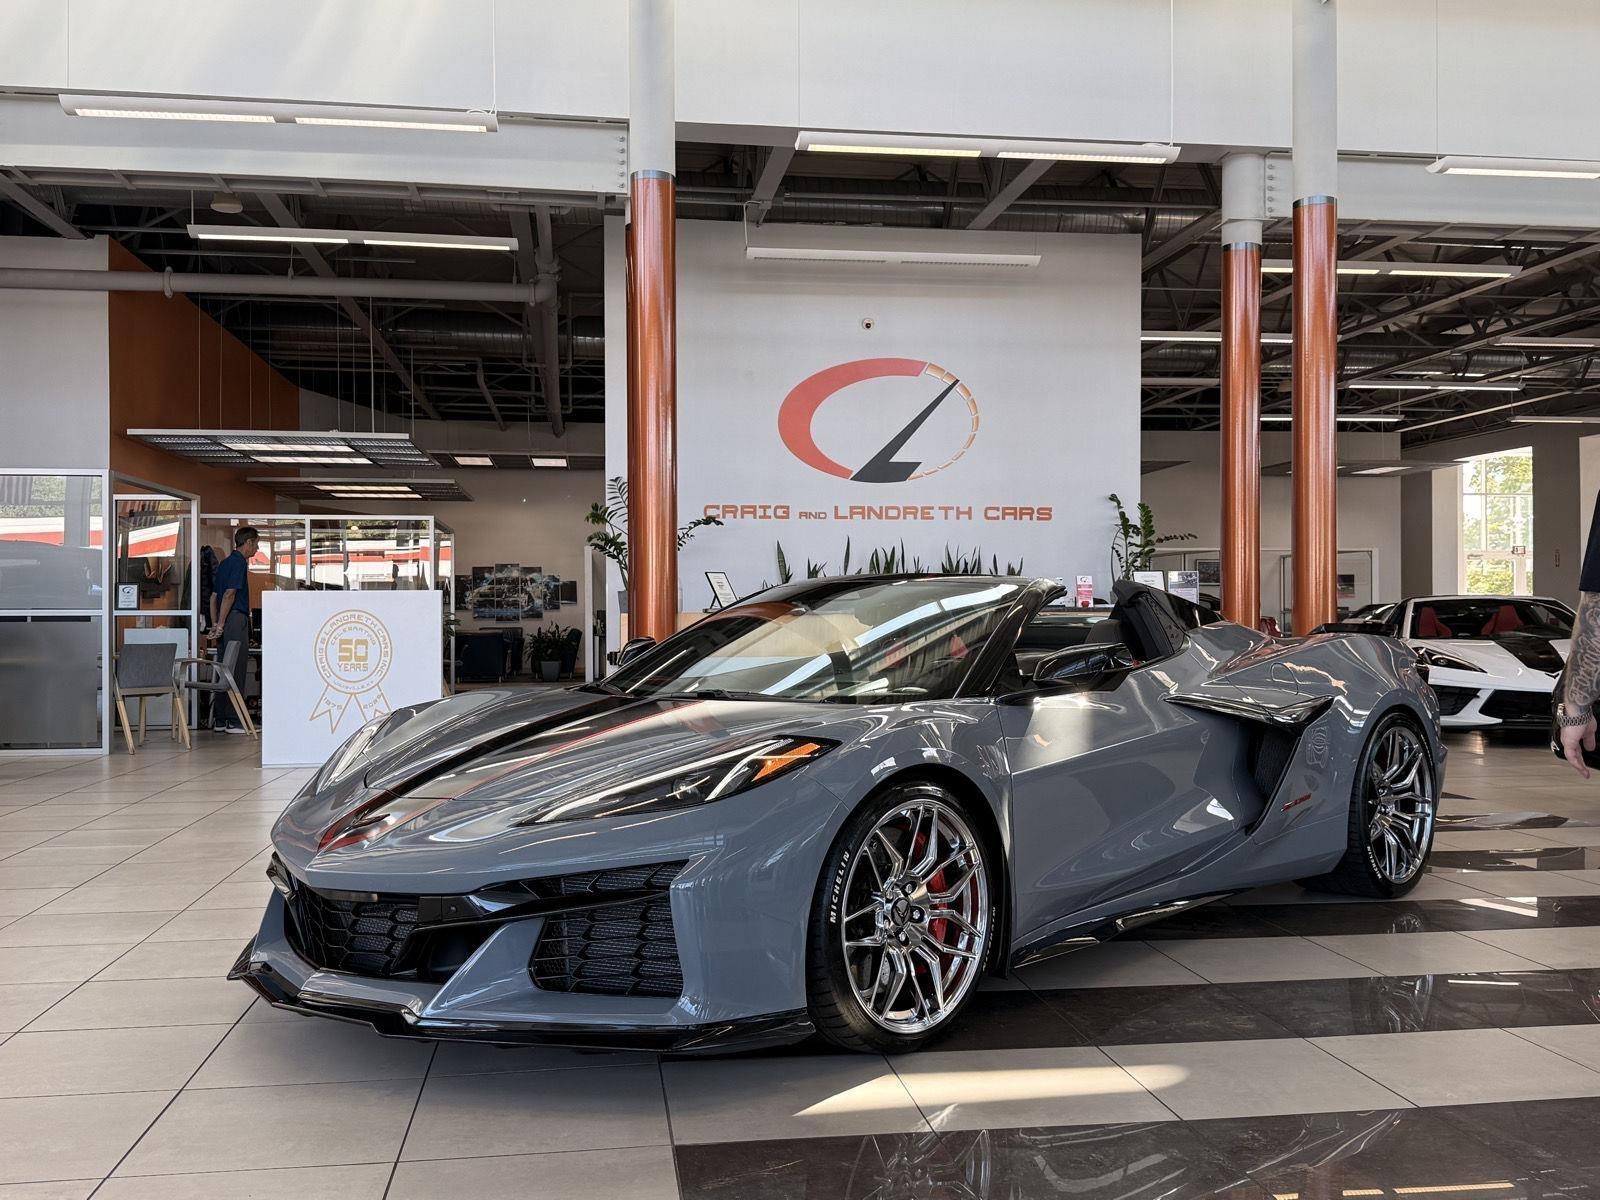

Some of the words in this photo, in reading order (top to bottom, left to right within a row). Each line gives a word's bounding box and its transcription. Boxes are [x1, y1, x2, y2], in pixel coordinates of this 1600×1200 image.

[703, 504, 790, 520] CRAIG
[799, 511, 827, 520] AND
[834, 505, 973, 520] LANDRETH
[984, 506, 1053, 521] CARS
[324, 614, 379, 636] LANDRETH
[338, 639, 368, 662] 50
[337, 663, 368, 672] YEARS
[830, 851, 850, 923] MICHELIN
